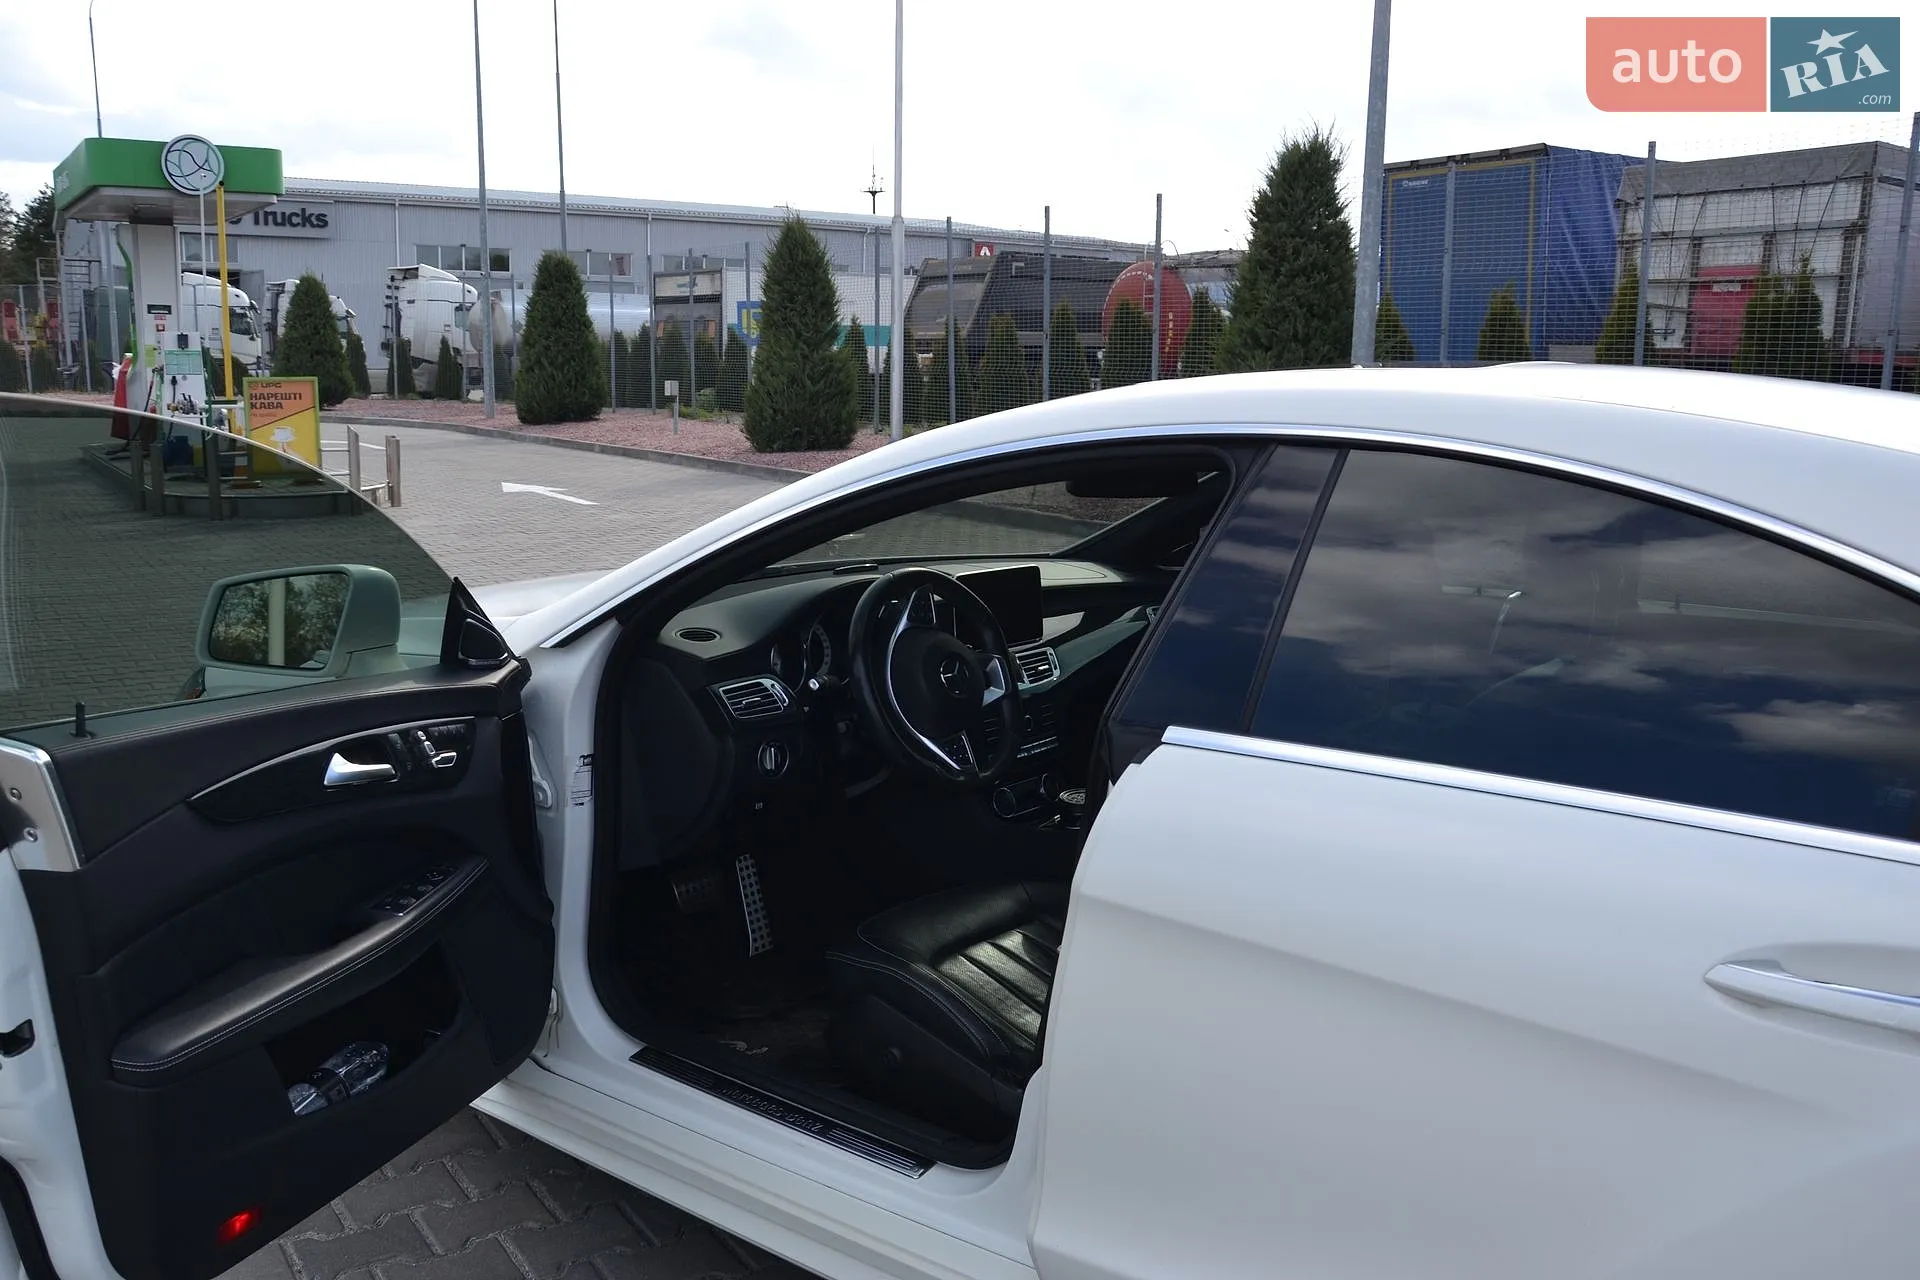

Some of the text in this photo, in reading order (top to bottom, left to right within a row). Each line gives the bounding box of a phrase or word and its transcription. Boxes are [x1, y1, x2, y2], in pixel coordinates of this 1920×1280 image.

[253, 207, 329, 229] Trucks
[249, 392, 303, 401] НАРЕШТІ
[249, 401, 284, 410] КАВА
